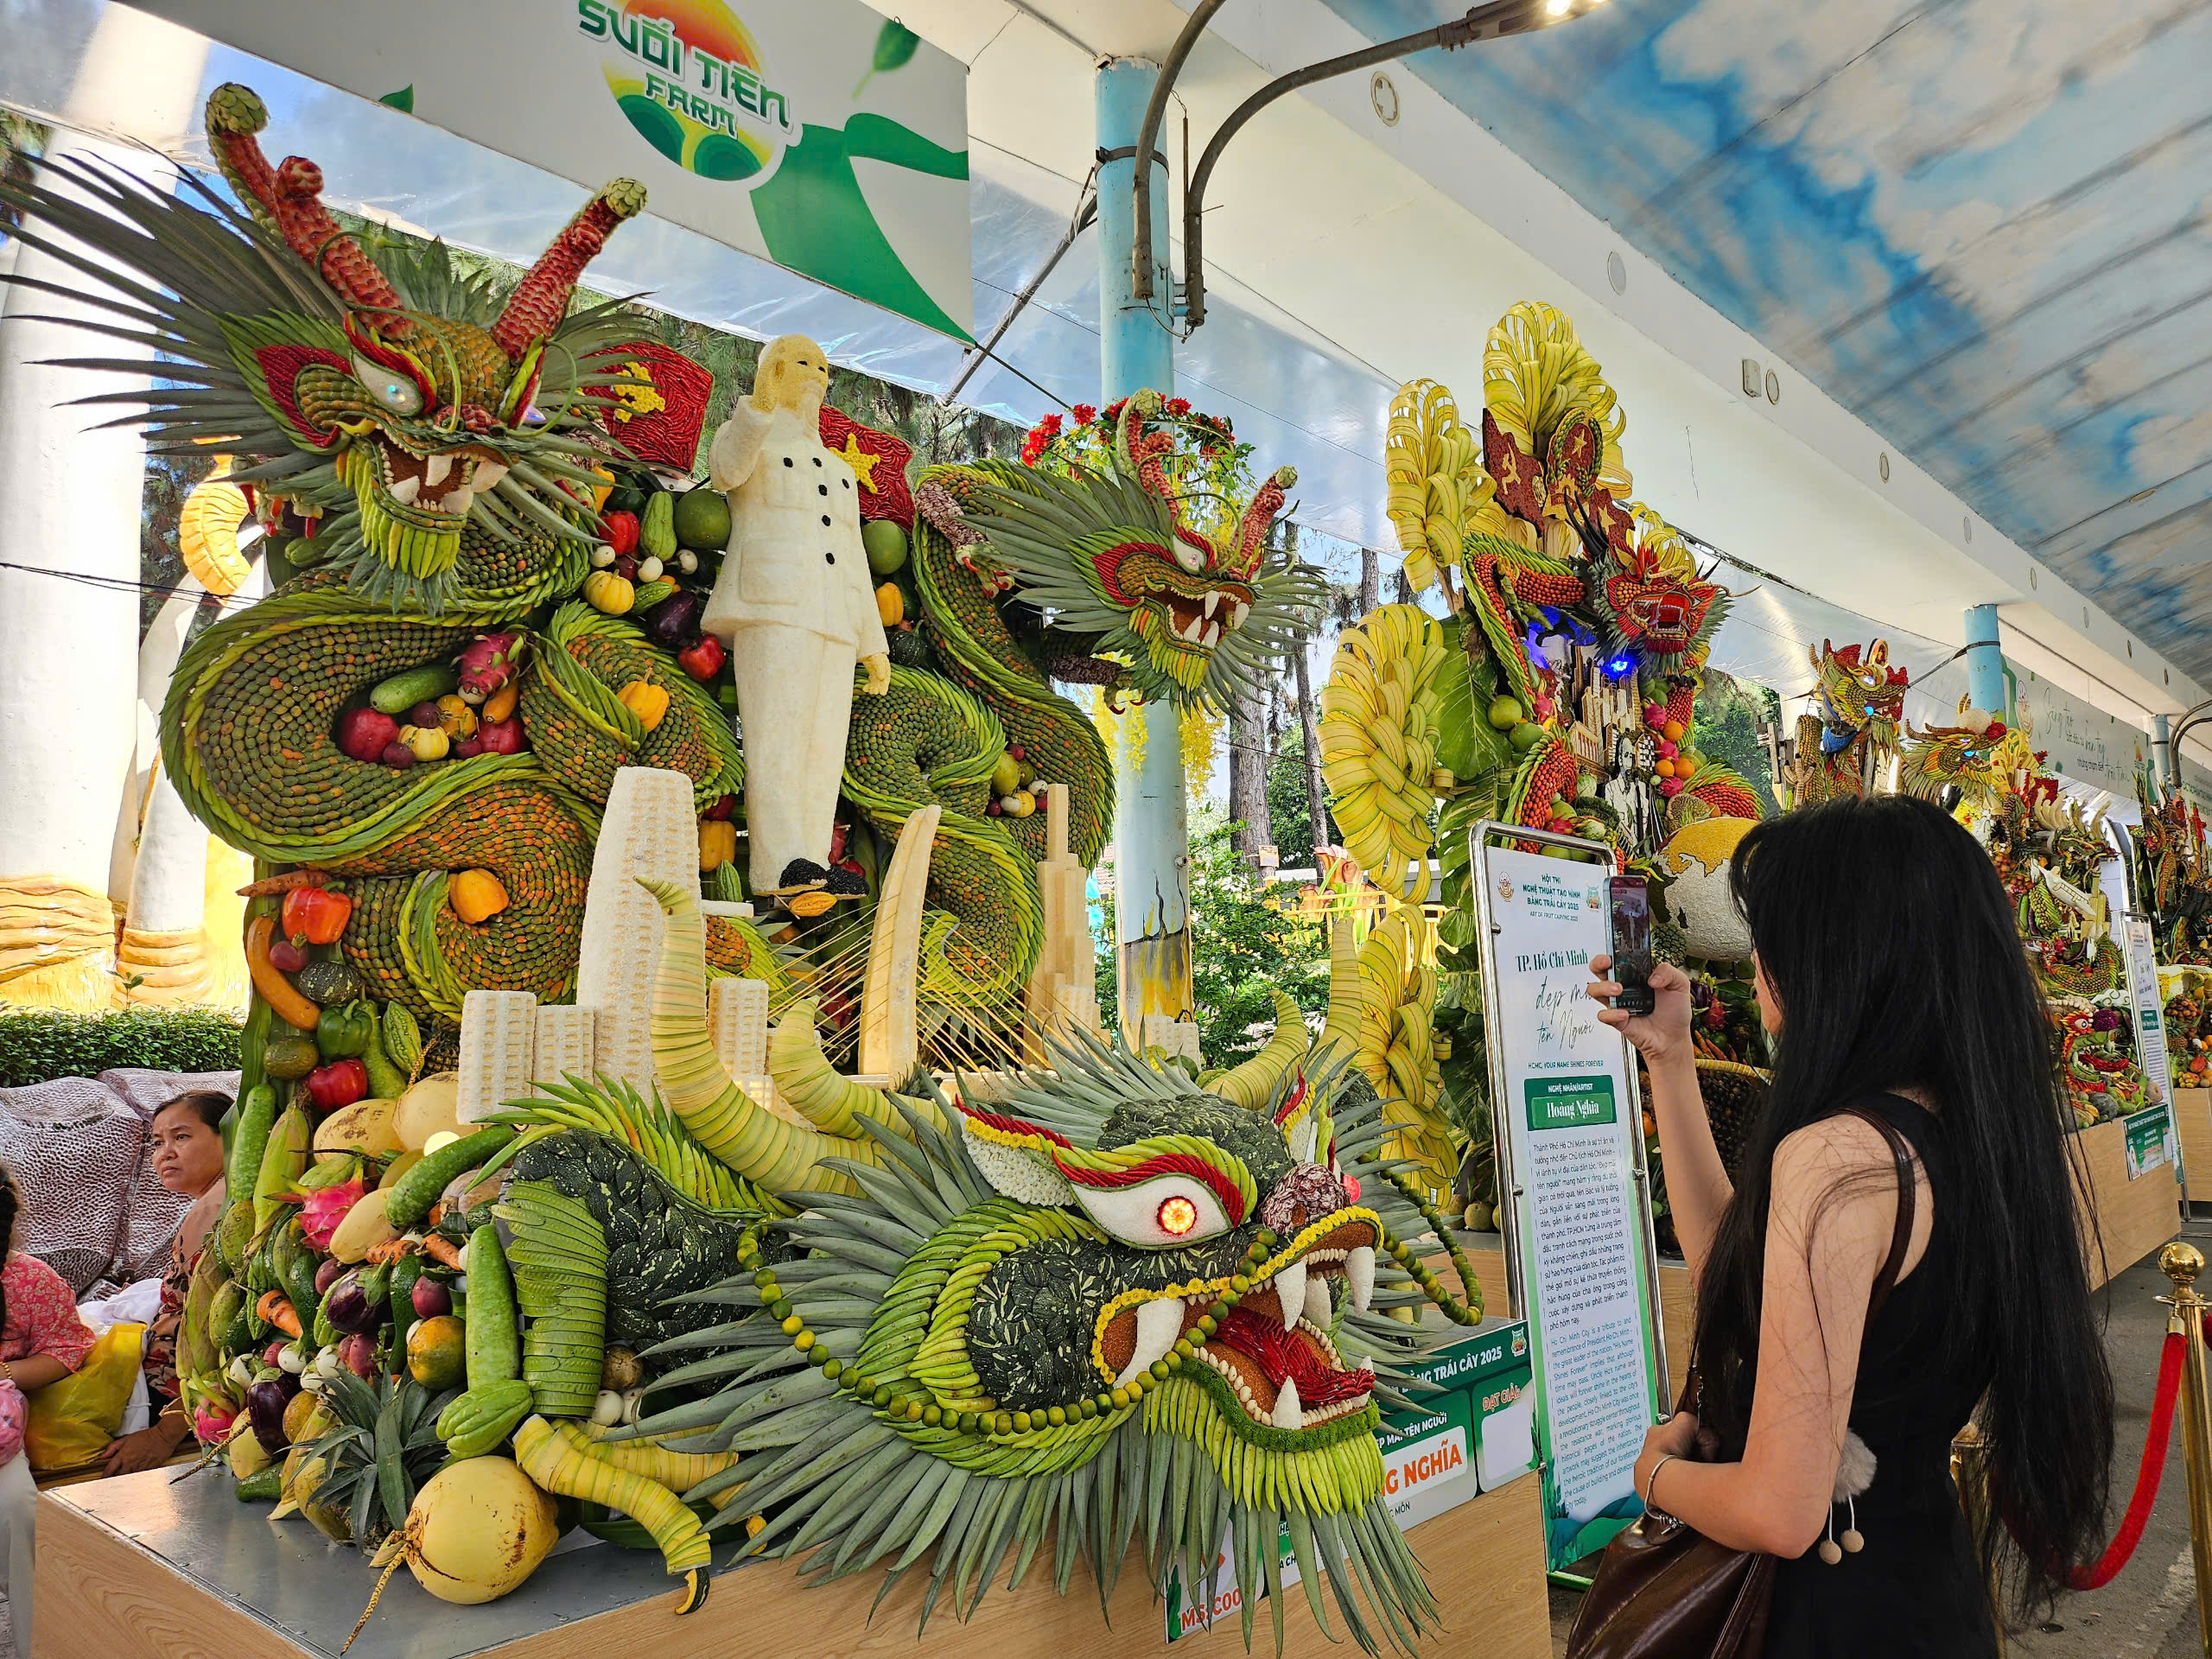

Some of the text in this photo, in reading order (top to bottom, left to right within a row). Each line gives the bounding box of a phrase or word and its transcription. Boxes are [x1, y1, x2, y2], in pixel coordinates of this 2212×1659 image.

[578, 0, 791, 129] SUỐI TIÊN
[645, 72, 737, 136] FARM
[1541, 874, 1552, 885] HỘI
[1522, 884, 1538, 895] NGHỆ
[1557, 889, 1567, 899] TẠO
[1516, 949, 1588, 972] TP. Hồ Chí Minh
[1548, 1084, 1562, 1094] NGHỆ
[1547, 1102, 1575, 1120] Hoàng
[1433, 1358, 1458, 1382] TRÁI
[1459, 1353, 1478, 1372] CÂY
[1480, 1346, 1503, 1365] 2025
[1483, 1392, 1501, 1412] ĐẠT
[1404, 1422, 1421, 1438] TÊN
[1403, 1439, 1463, 1488] NGHĨA
[1395, 1502, 1410, 1516] MÔN
